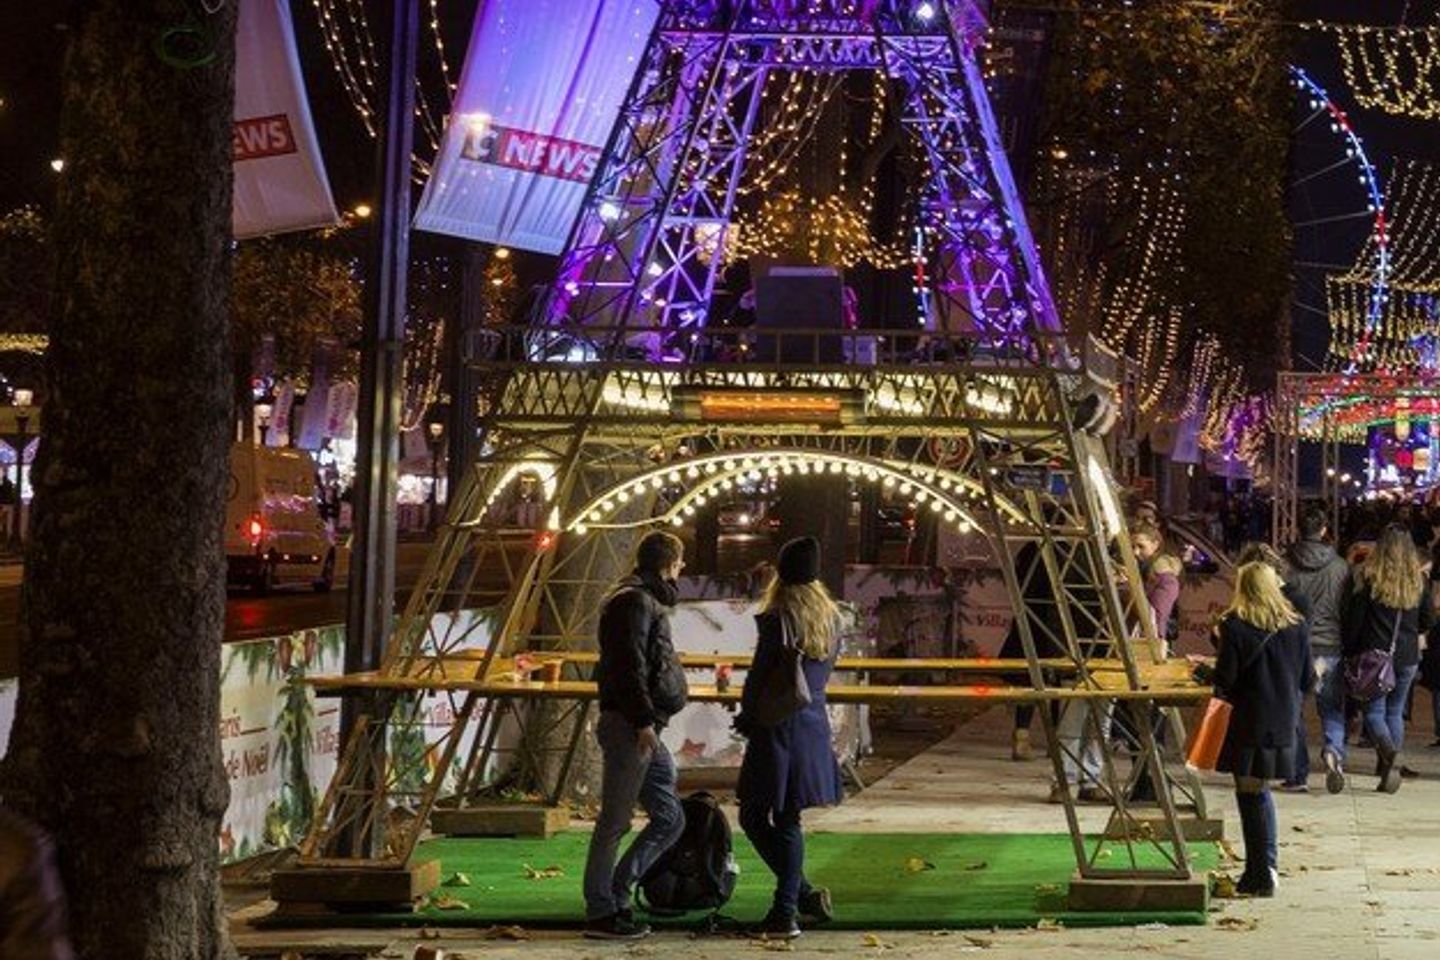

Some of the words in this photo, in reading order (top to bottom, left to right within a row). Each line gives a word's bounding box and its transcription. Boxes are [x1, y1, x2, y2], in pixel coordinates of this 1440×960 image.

[232, 121, 288, 155] EWS
[504, 134, 600, 178] NEWS
[976, 612, 1009, 629] Villa
[219, 715, 242, 738] aris
[312, 724, 340, 756] Villa
[242, 742, 270, 778] Noël
